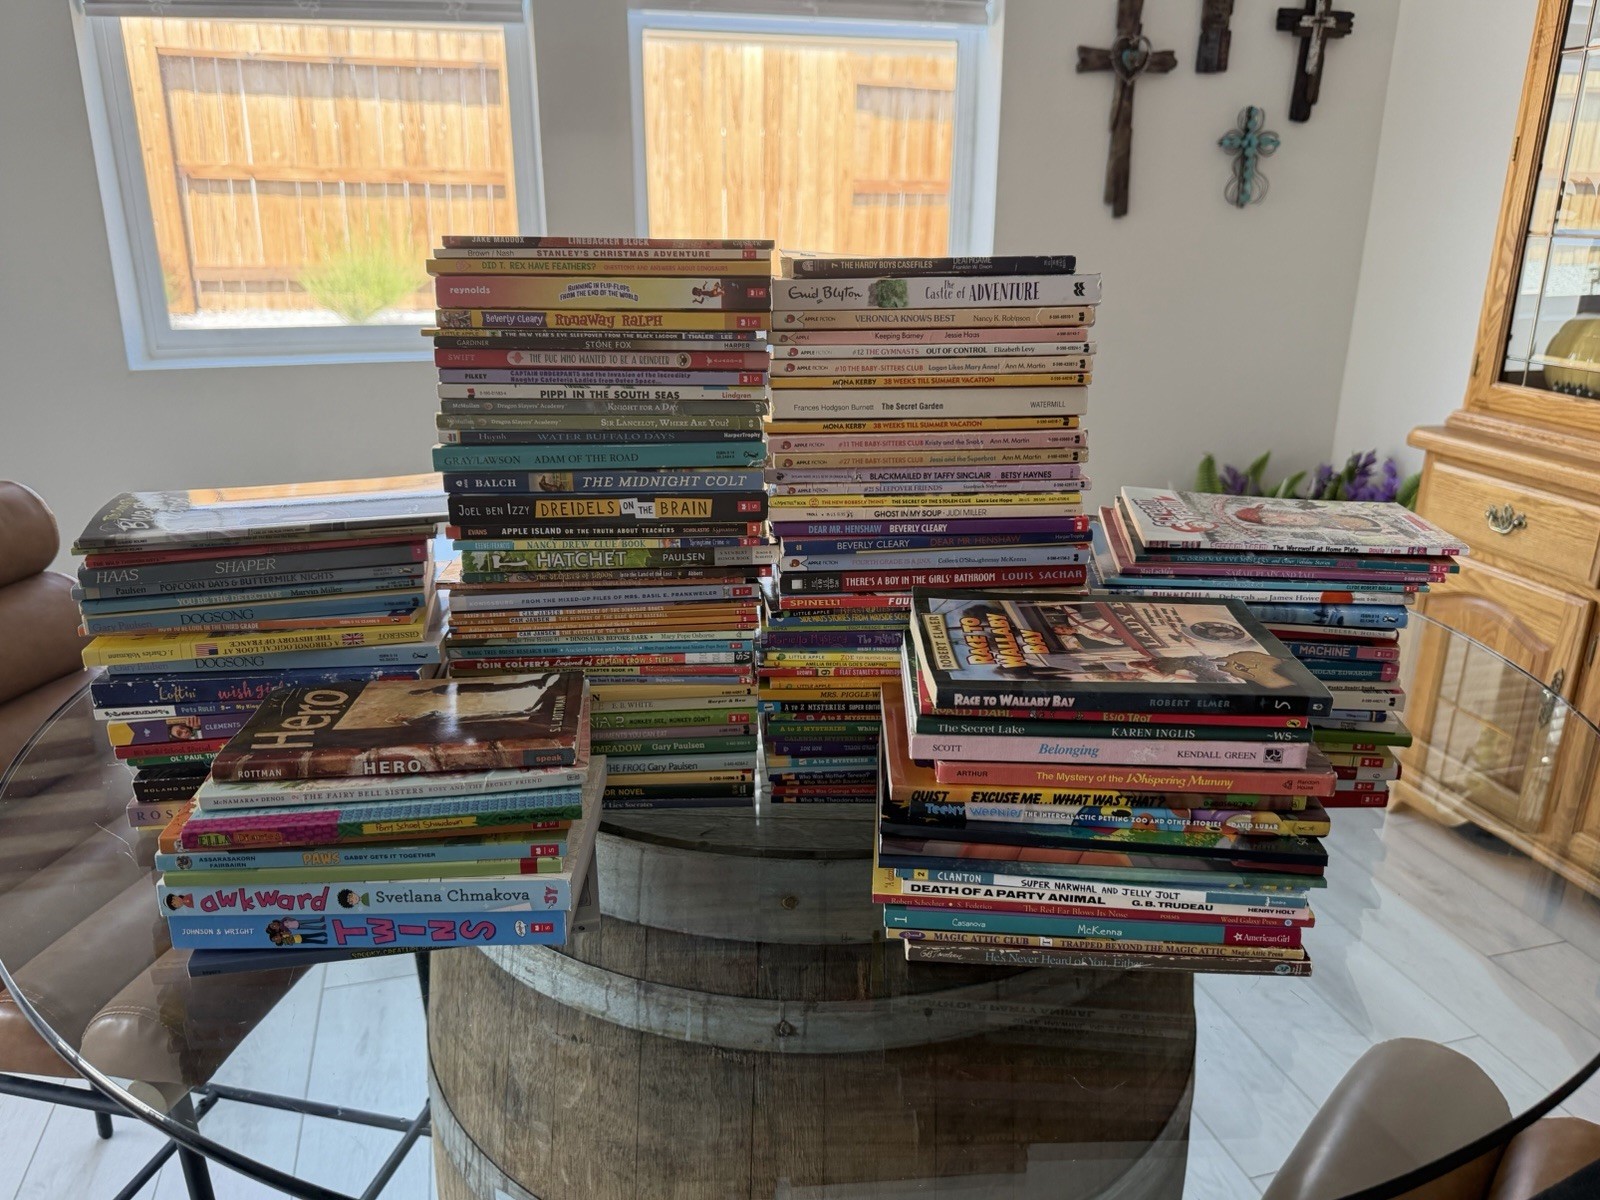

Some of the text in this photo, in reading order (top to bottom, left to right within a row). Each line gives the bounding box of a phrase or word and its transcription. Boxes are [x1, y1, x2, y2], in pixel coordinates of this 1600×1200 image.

[537, 250, 710, 258] STANLEY'S CHRISTMAS ADVENTURE
[482, 262, 596, 271] DID T. REX HAVE FEATHERS?
[841, 260, 932, 269] THE HARDY BOYS CASEFILES
[450, 286, 490, 294] reynolds
[944, 280, 955, 291] The
[789, 287, 862, 301] Enid Blyton
[925, 282, 1040, 301] Castle of ADVENTURE
[855, 314, 955, 322] VERONICA KNOWS BEST
[585, 341, 631, 349] STONE FOX
[954, 346, 987, 354] CONTROL
[540, 389, 679, 400] PIPPI IN THE SOUTH SEAS
[1031, 401, 1065, 409] WATERMILL
[534, 453, 639, 463] ADAM OF THE ROAD
[870, 471, 991, 480] BLACKMAILED BY TAFFY SINCLAIR
[1001, 470, 1051, 479] BETSY HAYNES
[475, 478, 516, 487] BALCH
[583, 475, 747, 487] THE MIDNIGHT COLT
[541, 500, 707, 516] DREIDELS ON THE BRAIN
[874, 510, 897, 518] GHOST
[922, 509, 941, 517] SOUP
[963, 508, 987, 516] MILLER
[808, 524, 881, 534] DEAR MR. HENSHAW
[889, 523, 947, 533] BEVERLY CLEARY
[837, 539, 910, 550] BEVERLY CLEARY
[536, 552, 627, 568] HATCHET
[662, 552, 705, 561] PAULSEN
[215, 558, 275, 573] SHAPER
[97, 570, 139, 583] HAAS
[845, 576, 874, 587] THERE'S
[876, 577, 881, 585] A
[884, 576, 899, 585] BOY
[901, 576, 909, 584] IN
[911, 575, 926, 584] THE
[954, 573, 996, 582] BATHROOM
[1002, 570, 1082, 580] LOUIS SACHAR
[160, 581, 205, 591] POPCORN
[208, 579, 229, 589] DAYS
[240, 574, 297, 587] BUTTERMILK
[300, 571, 334, 581] NIGHTS
[116, 586, 146, 595] Paulsen
[180, 609, 253, 624] DOGSONG
[1299, 645, 1349, 658] MACHINE
[195, 656, 264, 669] DOGSONG
[1149, 698, 1230, 708] ROBERT ELMER
[251, 690, 348, 749] Hero
[205, 721, 241, 731] CLEMENTS
[938, 724, 1025, 734] The Secret Lake
[1112, 728, 1195, 738] KAREN INGLIS
[933, 744, 962, 753] SCOTT
[1038, 743, 1099, 758] Belonging
[536, 753, 563, 763] speak
[1177, 750, 1256, 760] KENDALL GREEN
[363, 760, 421, 774] HERO
[648, 762, 698, 772] Gary Paulsen
[238, 769, 282, 778] ROTTMAN
[957, 770, 987, 778] ARTHUR
[1037, 771, 1233, 789] The Mystery of the Whispering Mummy
[304, 786, 424, 799] THE FAIRY BELL SISTERS
[303, 852, 339, 864] PAWS
[937, 872, 981, 883] CLANTON
[911, 884, 1106, 904] DEATH OF A PARTY ANIMAL
[1021, 879, 1180, 900] SUPER NARWHAL AND JELLY JOLT
[201, 886, 330, 912] awkward
[375, 888, 530, 903] Svetlana Chmakova
[1132, 900, 1143, 908] G.
[1158, 902, 1213, 911] TRUDEAU
[952, 918, 986, 928] Casanova
[332, 918, 497, 945] TWINS
[1078, 925, 1122, 936] McKenna
[933, 932, 1030, 945] MAGIC ATTIC CLUB
[1061, 940, 1227, 955] TRAPPED BEYOND THE MAGIC ATTIC
